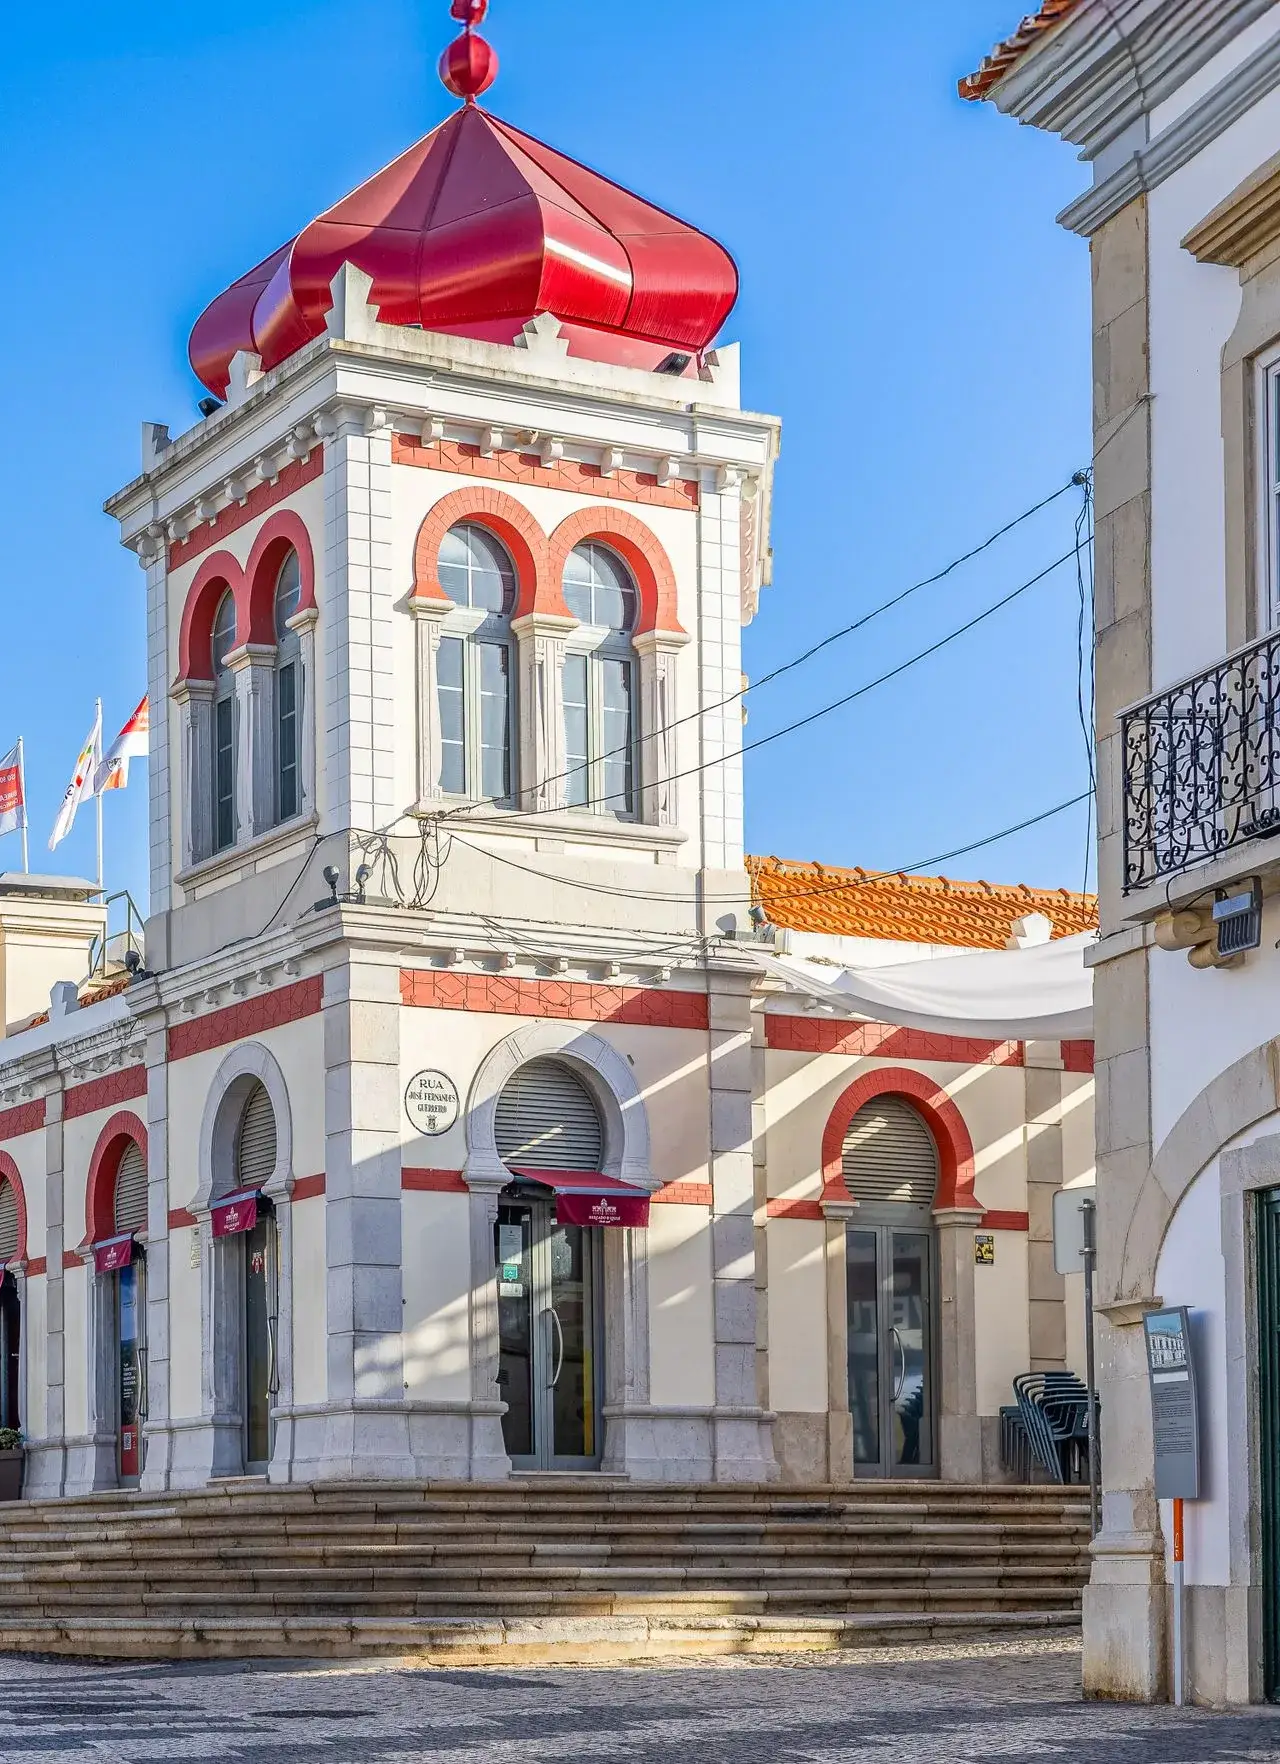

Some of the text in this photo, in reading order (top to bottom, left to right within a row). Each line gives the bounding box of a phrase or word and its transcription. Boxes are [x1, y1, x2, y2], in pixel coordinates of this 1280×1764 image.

[419, 1079, 444, 1089] RUA
[408, 1090, 456, 1103] JOSÉ FERNANDES
